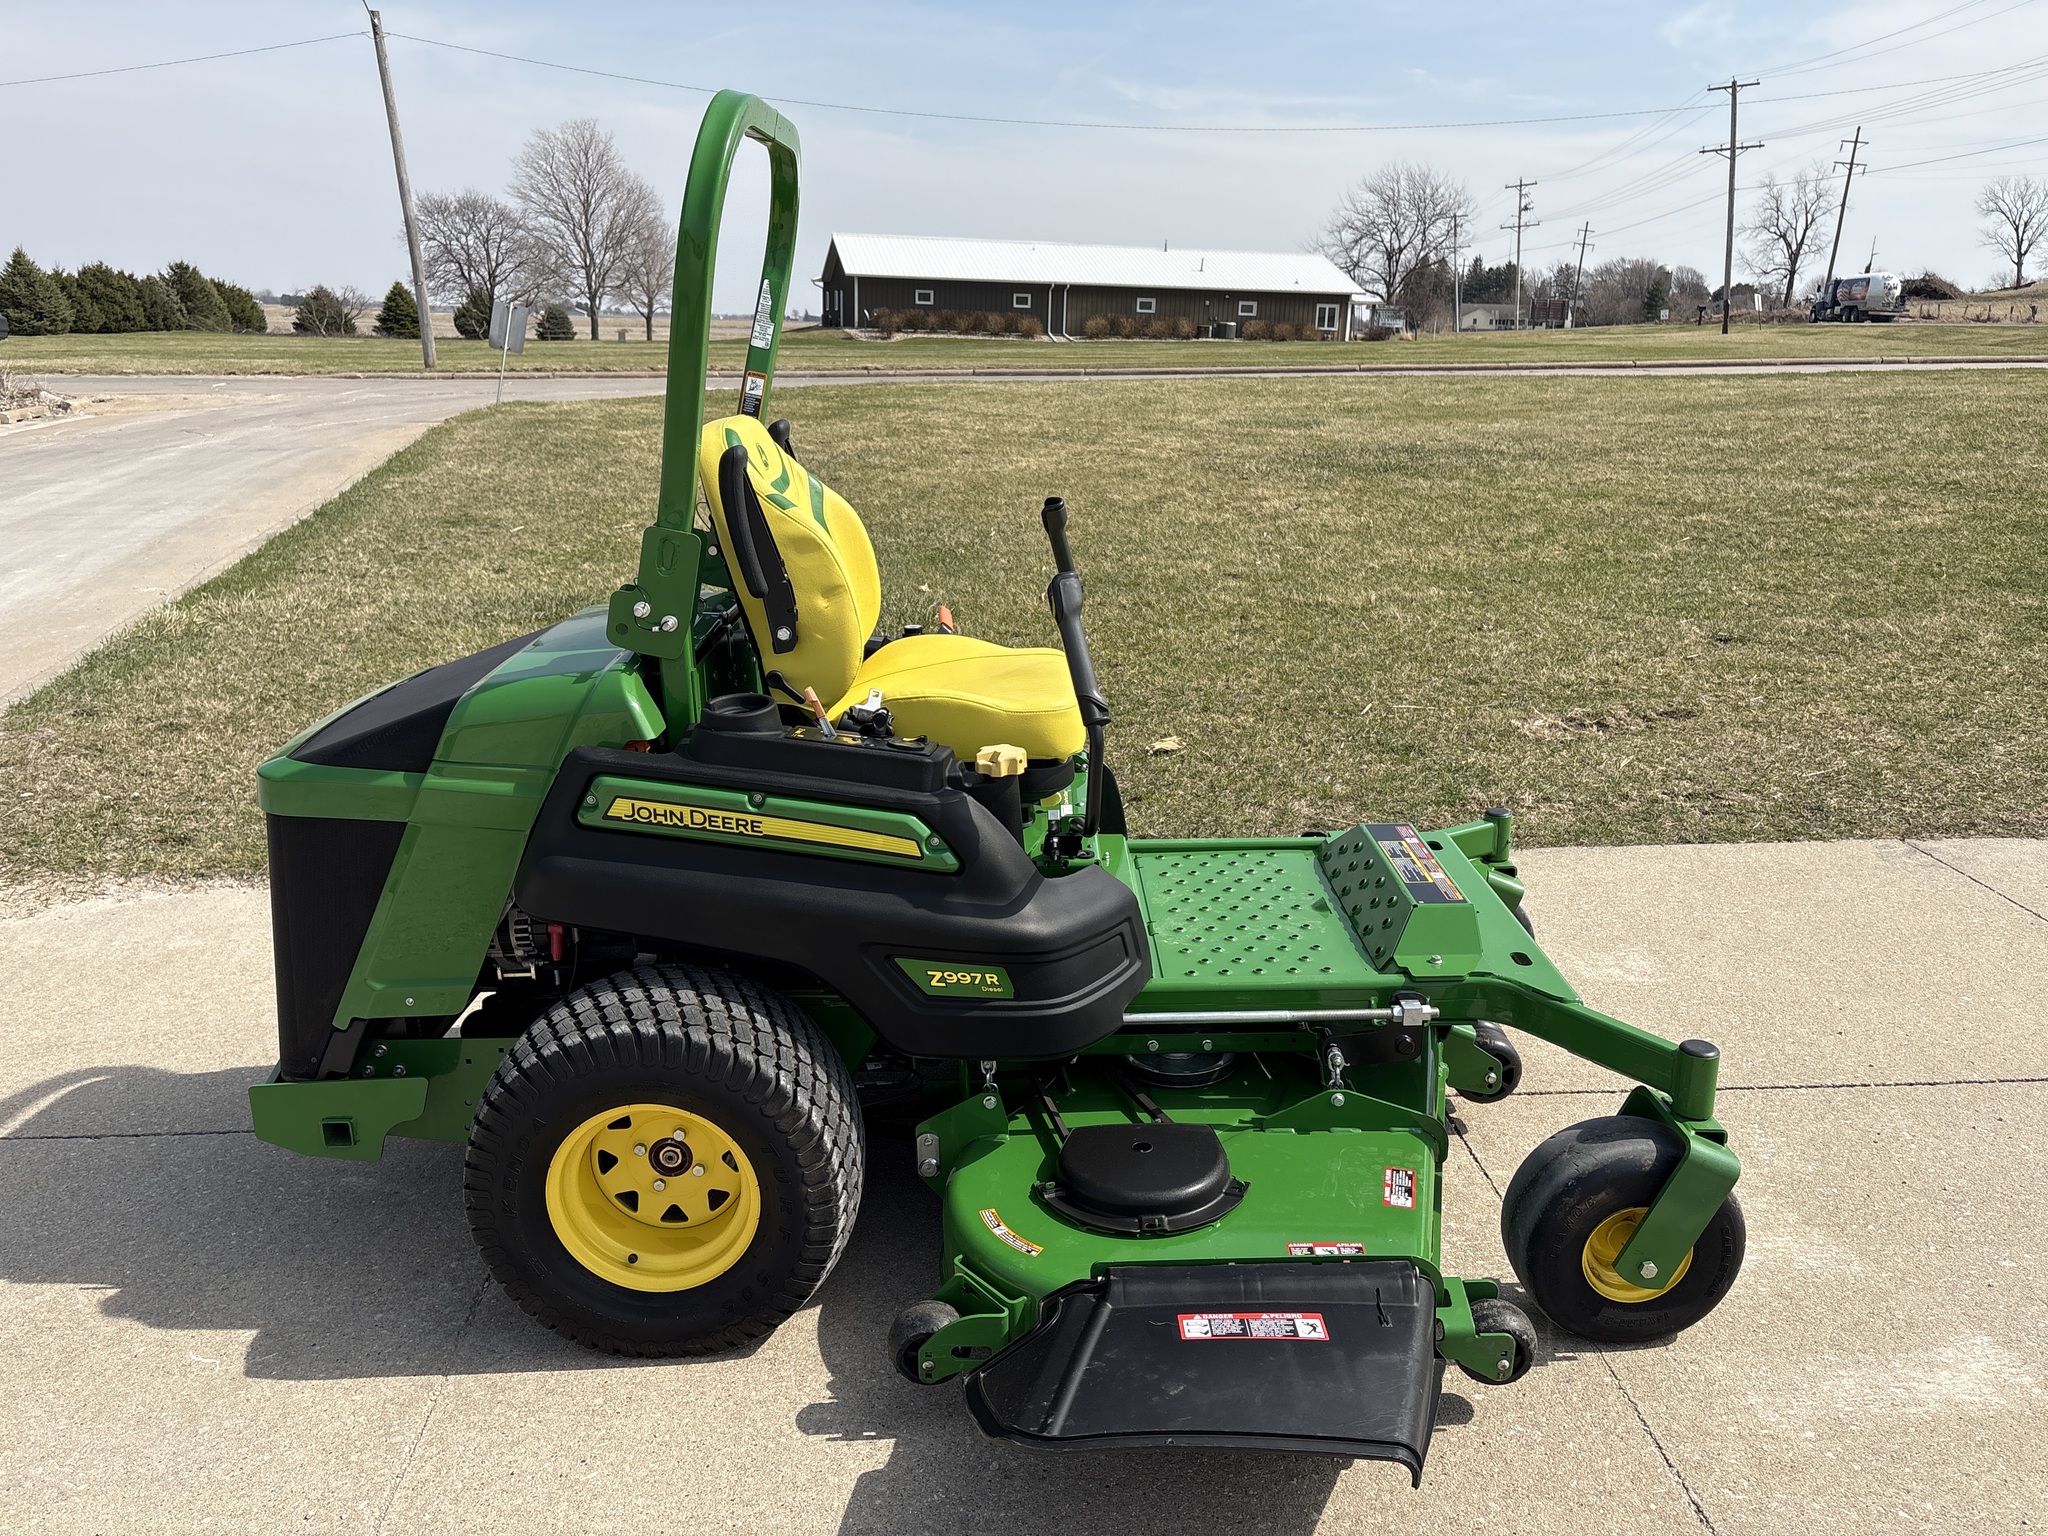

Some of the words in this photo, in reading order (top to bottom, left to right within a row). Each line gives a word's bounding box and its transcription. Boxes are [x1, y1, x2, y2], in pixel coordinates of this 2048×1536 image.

[623, 802, 685, 825] JOHN
[690, 808, 763, 834] DEERE
[501, 1116, 549, 1219] KENDA
[760, 1142, 792, 1244] TURF
